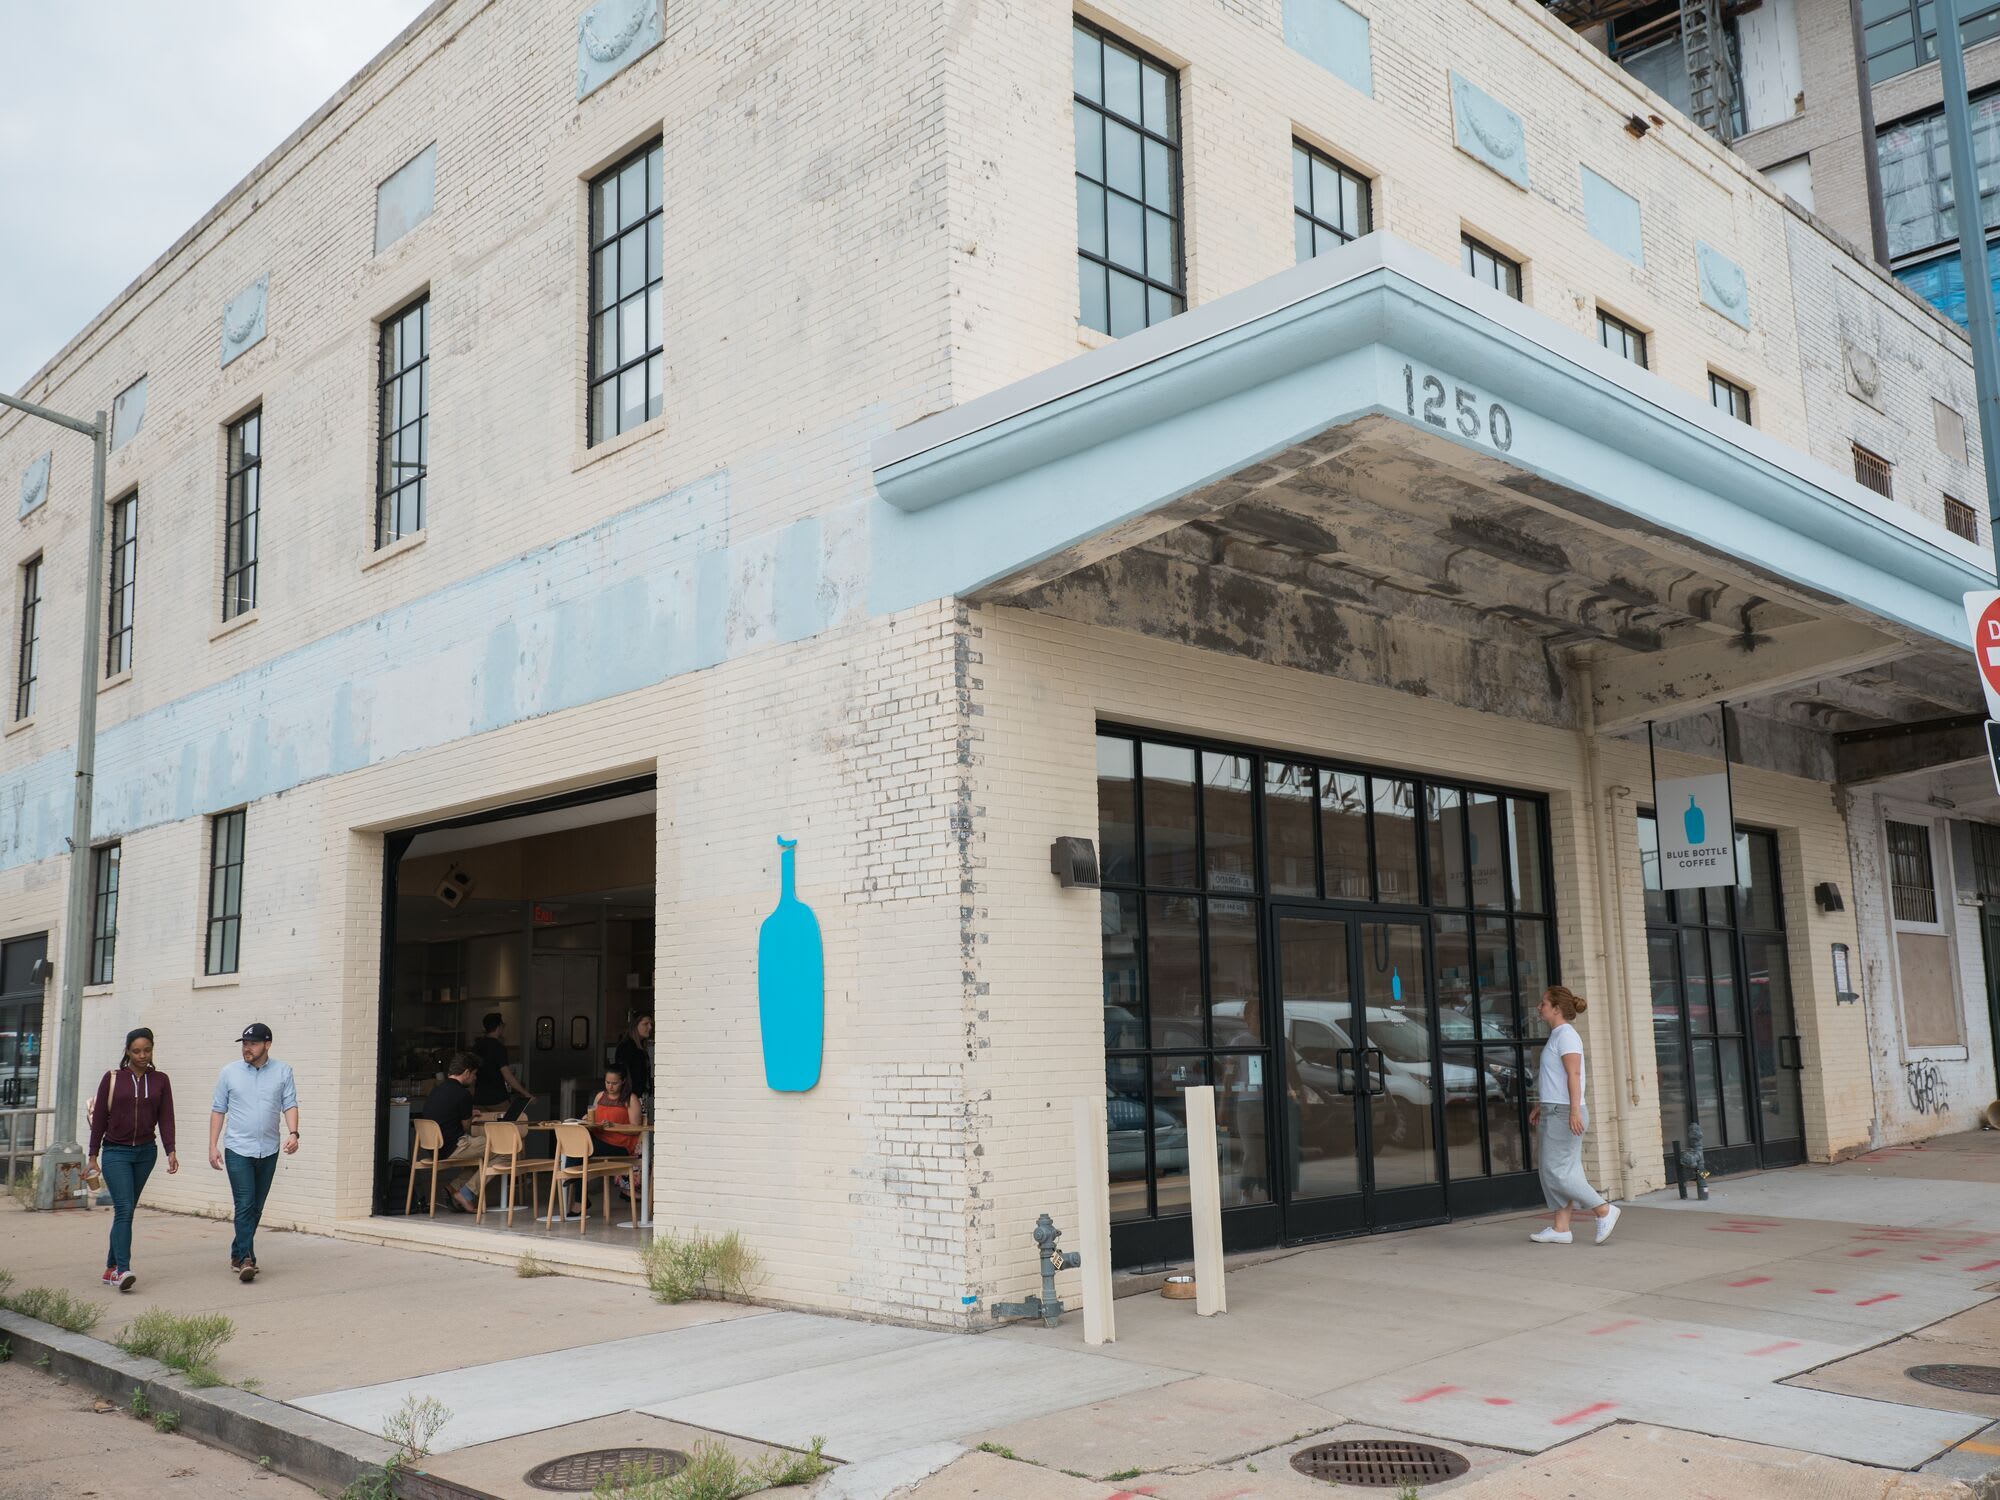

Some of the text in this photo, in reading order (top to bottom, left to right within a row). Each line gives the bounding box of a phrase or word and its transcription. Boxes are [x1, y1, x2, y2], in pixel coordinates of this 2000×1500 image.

[1402, 363, 1513, 453] 1250
[1666, 847, 1727, 859] BLUE BOTTLE
[1679, 859, 1716, 867] COFFEE
